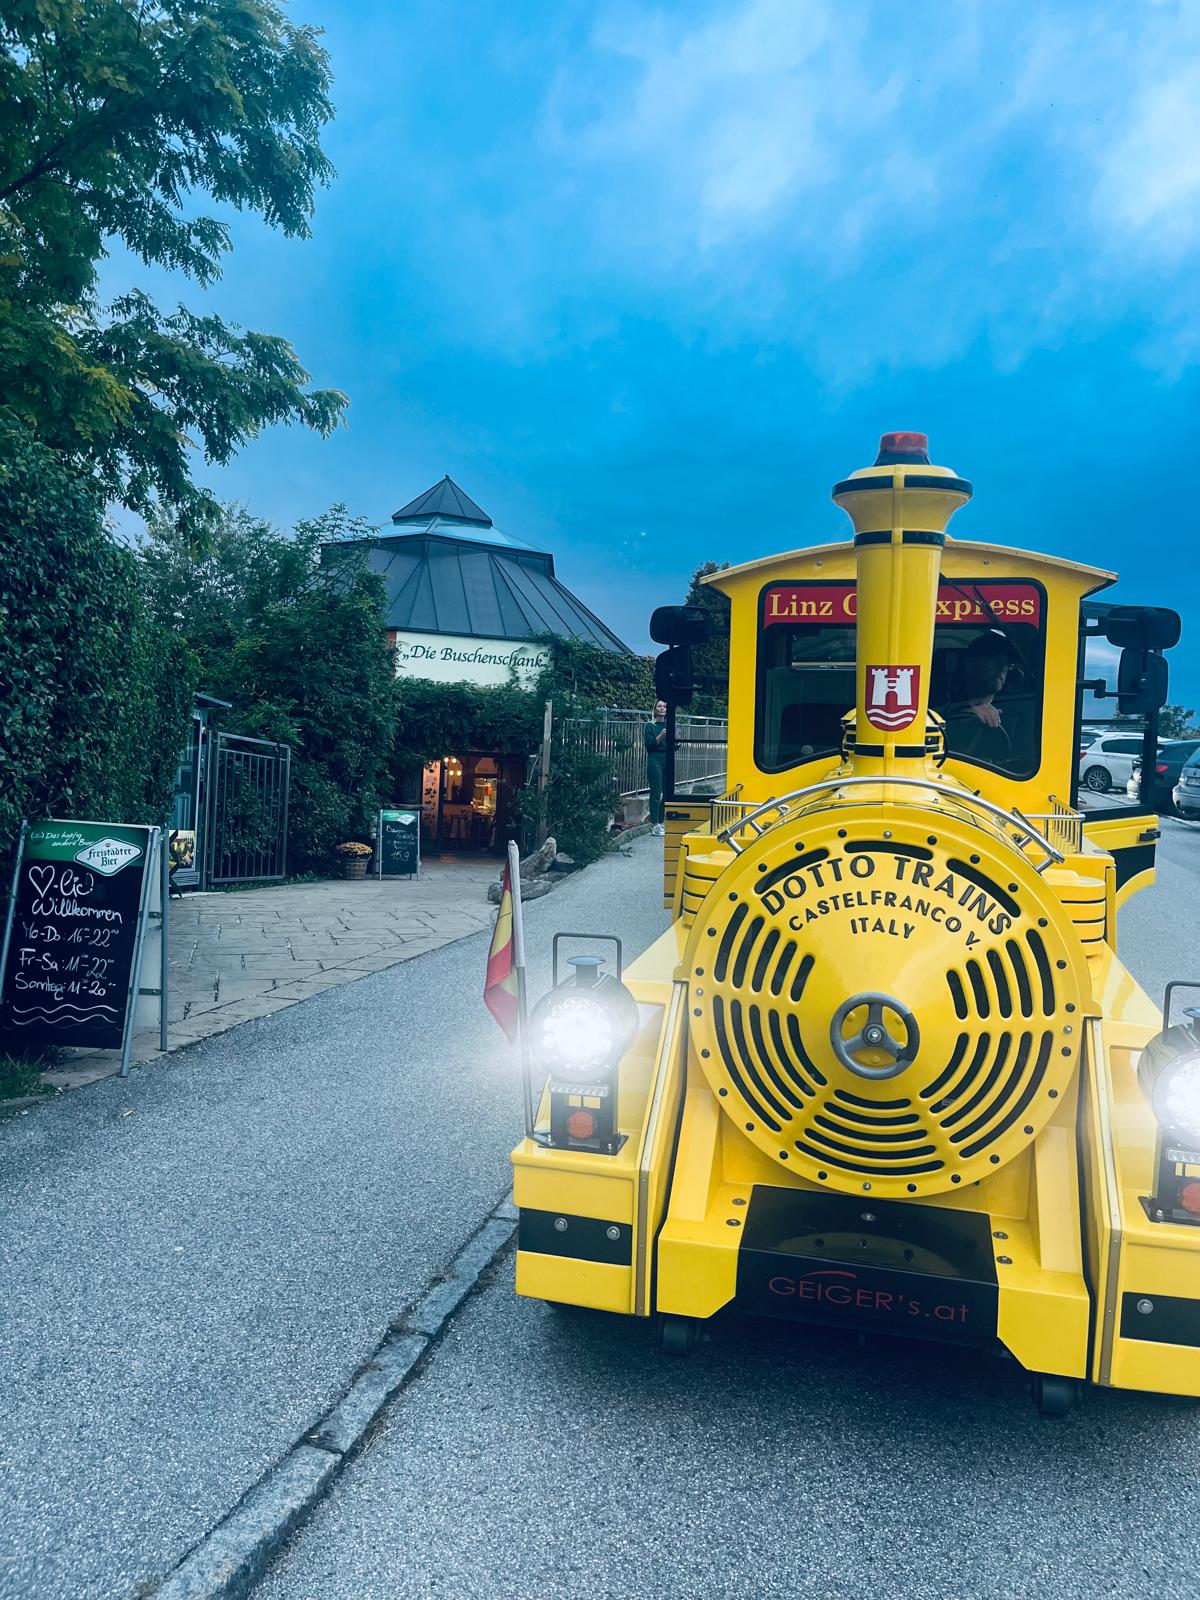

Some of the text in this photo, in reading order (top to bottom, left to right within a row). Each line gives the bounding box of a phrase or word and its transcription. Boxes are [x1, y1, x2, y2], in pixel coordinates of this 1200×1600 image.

[769, 594, 833, 616] Linz
[936, 599, 1035, 621] xpress
[100, 857, 119, 867] Bier
[760, 855, 1012, 935] DOTTO TRAINS
[31, 897, 122, 924] Willkommen
[789, 890, 962, 932] CASTELFRANCO
[850, 917, 915, 939] ITALY
[768, 1276, 968, 1322] GEIGER's.at
